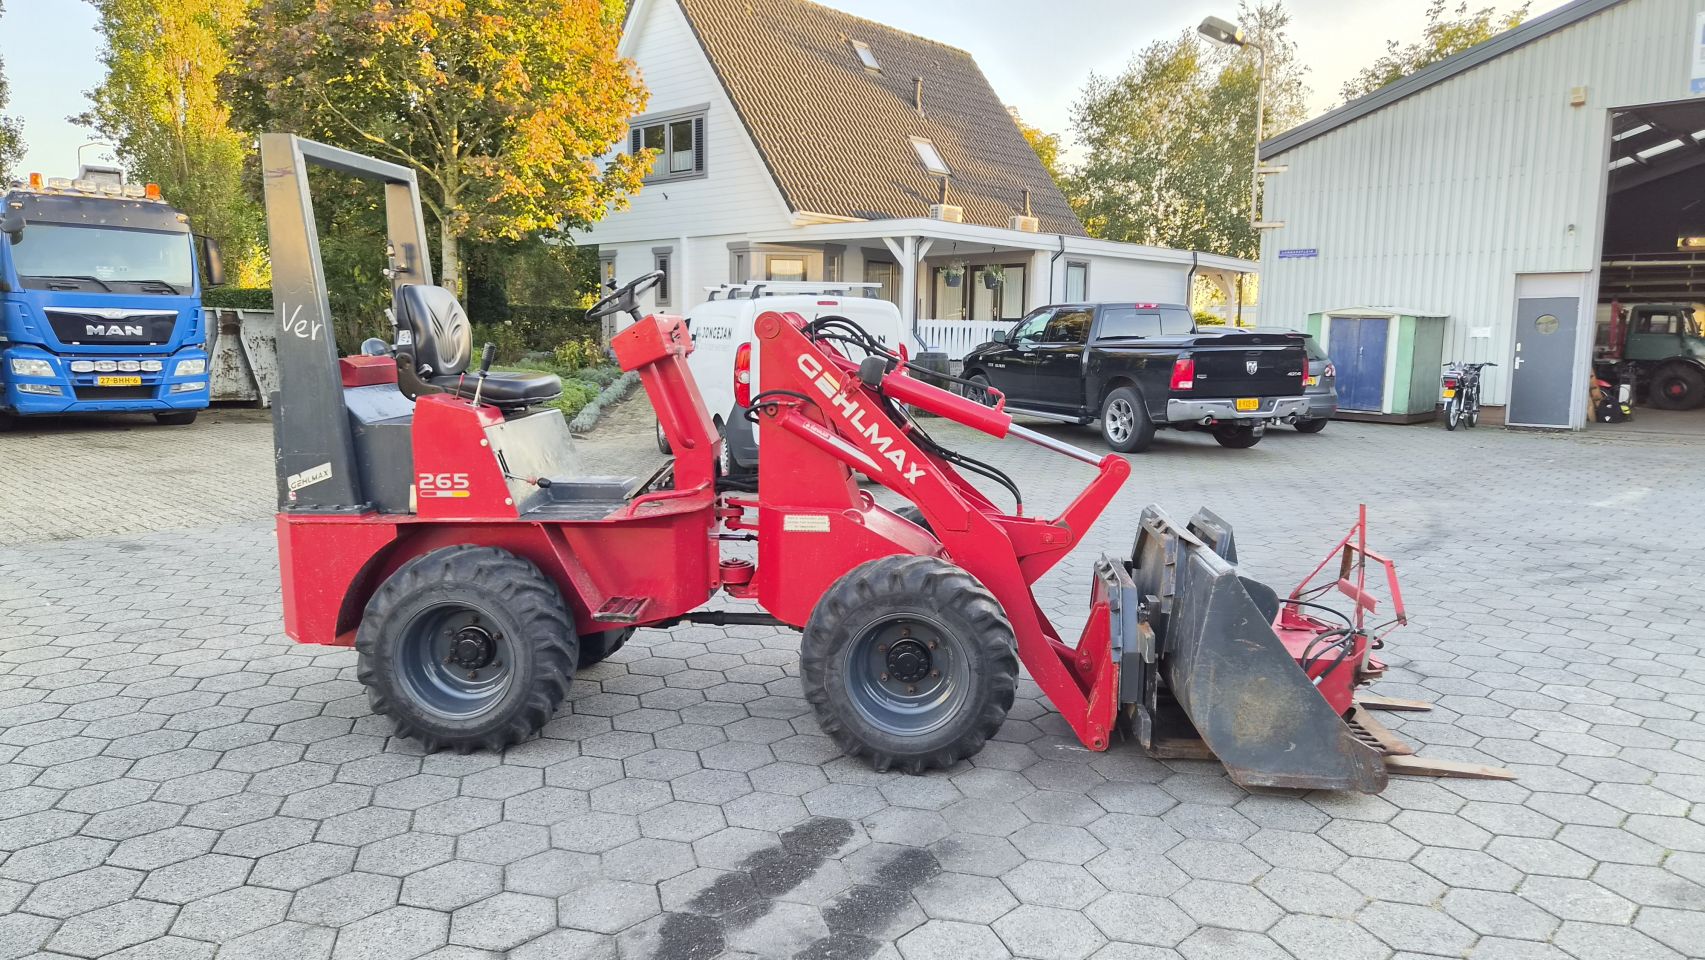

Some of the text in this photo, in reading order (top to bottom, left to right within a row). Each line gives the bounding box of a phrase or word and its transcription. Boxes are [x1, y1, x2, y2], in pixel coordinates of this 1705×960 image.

[86, 325, 143, 336] MAN
[282, 301, 323, 341] Ver
[797, 353, 926, 485] GEHLMAX
[418, 473, 470, 489] 265
